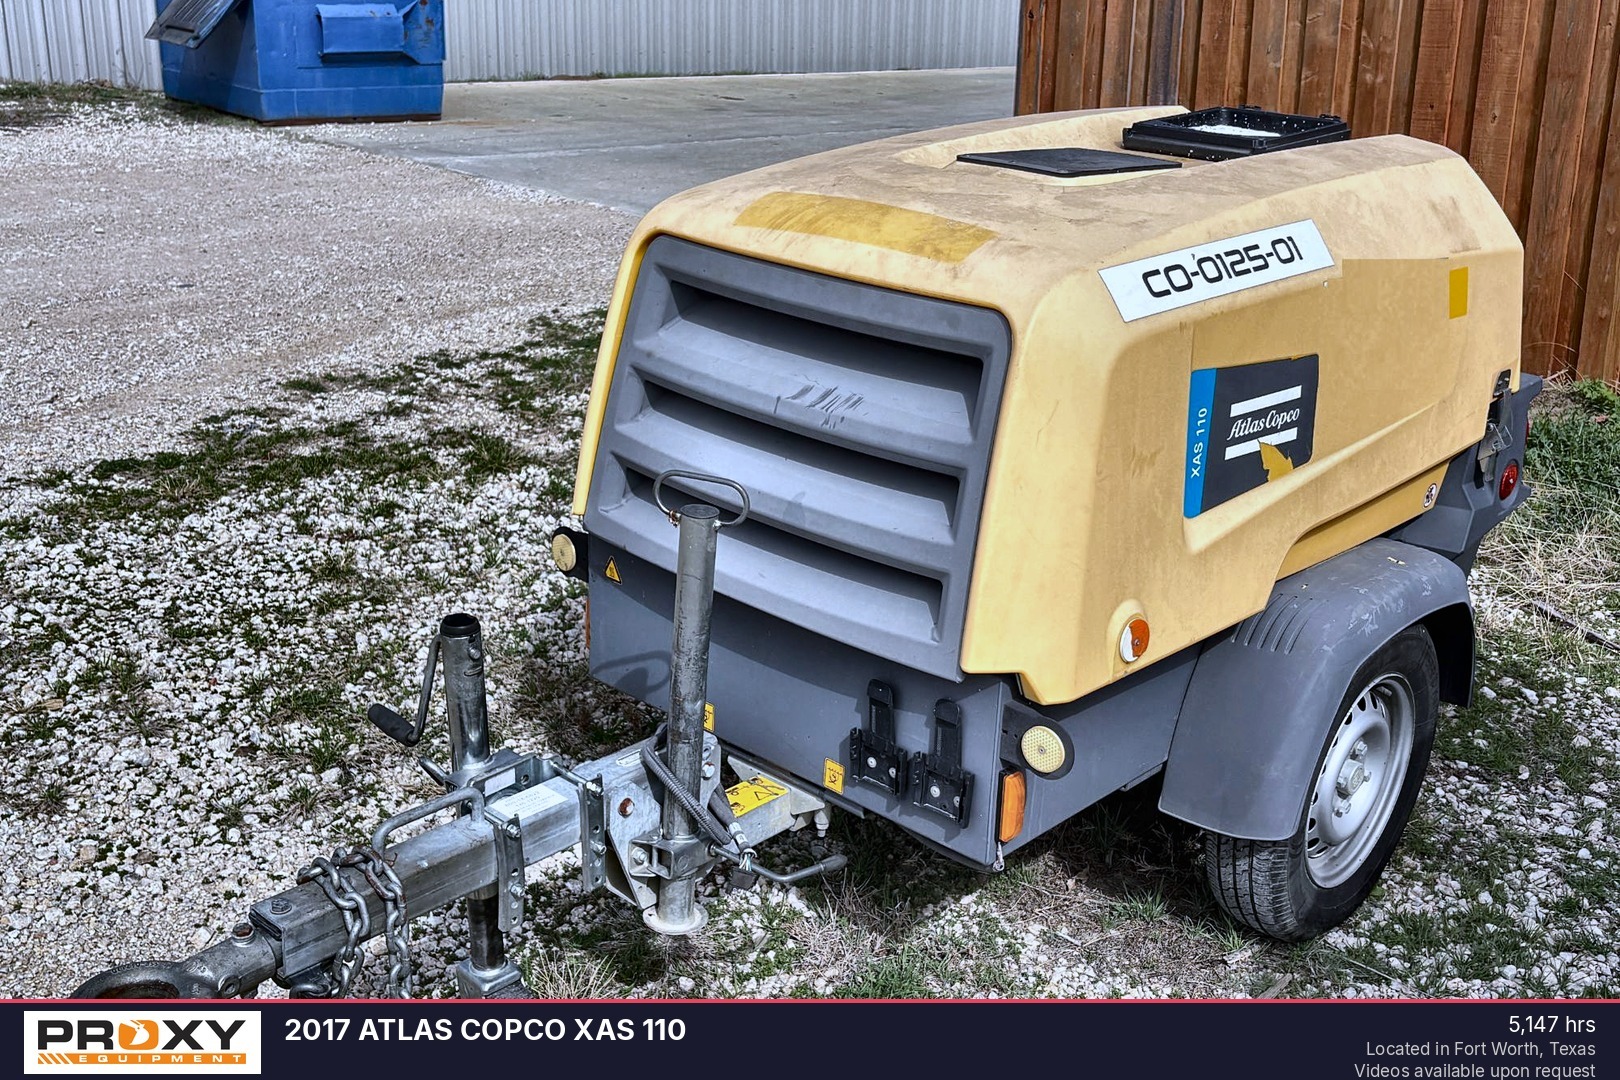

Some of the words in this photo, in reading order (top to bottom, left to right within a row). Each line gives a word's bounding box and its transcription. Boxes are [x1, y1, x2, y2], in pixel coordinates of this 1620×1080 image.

[1142, 235, 1304, 298] CO-0125-01
[1195, 407, 1208, 437] 110
[1226, 417, 1265, 441] Atlas
[1265, 408, 1300, 430] Copco
[1190, 441, 1204, 479] XAS
